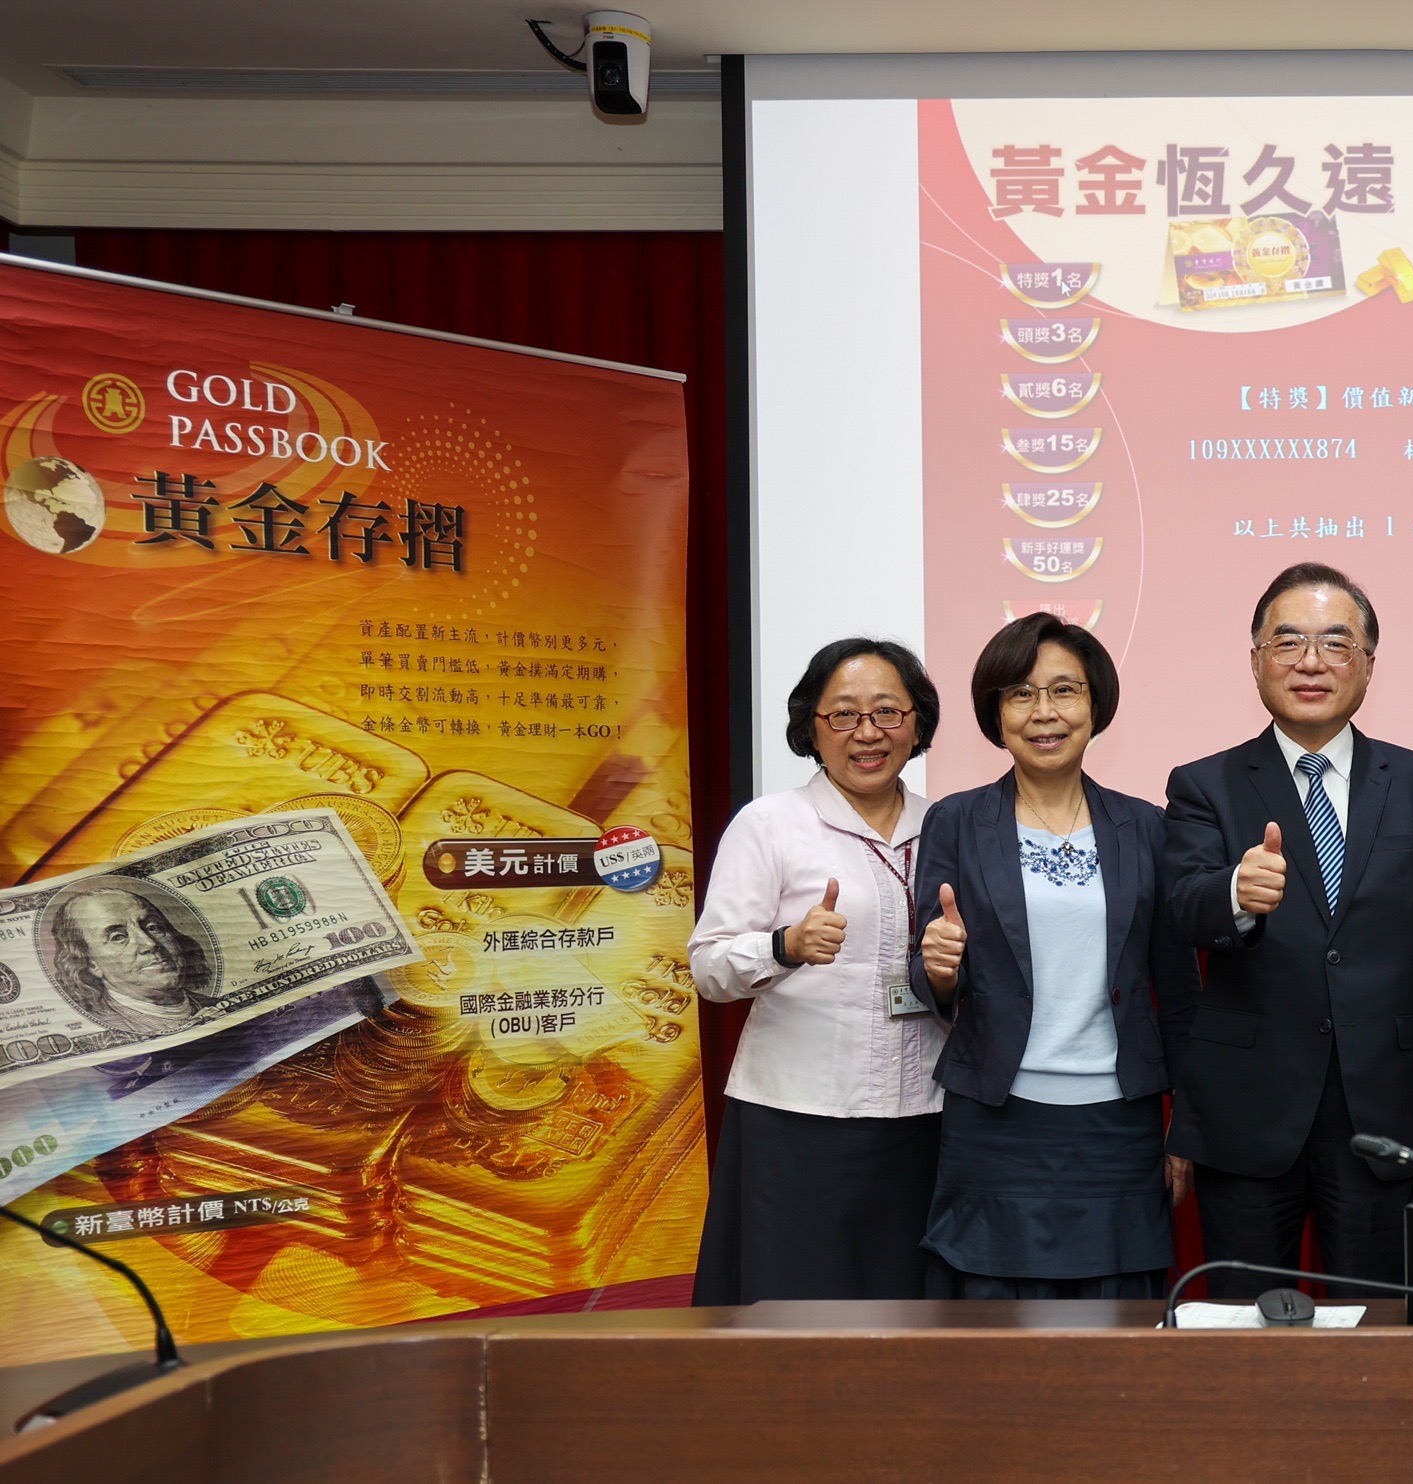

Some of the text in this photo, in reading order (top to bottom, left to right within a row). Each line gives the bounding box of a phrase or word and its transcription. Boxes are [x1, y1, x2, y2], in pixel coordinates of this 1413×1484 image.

[988, 142, 1395, 219] 黃金恆久遠
[1017, 268, 1082, 289] 特獎1名
[1018, 323, 1082, 343] 頭獎3名
[166, 369, 297, 415] GOLD
[1018, 378, 1083, 398] 貳獎6名
[167, 414, 393, 472] PASSBOOK
[1189, 438, 1357, 460] 109XXXXXX874
[1017, 489, 1089, 507] 肆獎25名
[129, 469, 466, 572] 黃金存摺
[1233, 516, 1365, 539] 以上共抽出
[1021, 542, 1085, 555] 新手好運獎
[1033, 556, 1073, 574] 50名
[464, 848, 579, 877] 美元計價
[323, 921, 387, 951] 100
[483, 926, 615, 953] 外匯綜合存款戶
[460, 986, 605, 1016] 國際金融業務分行
[491, 1012, 576, 1038] (OBU)客戶
[75, 1200, 224, 1236] 新臺幣計價
